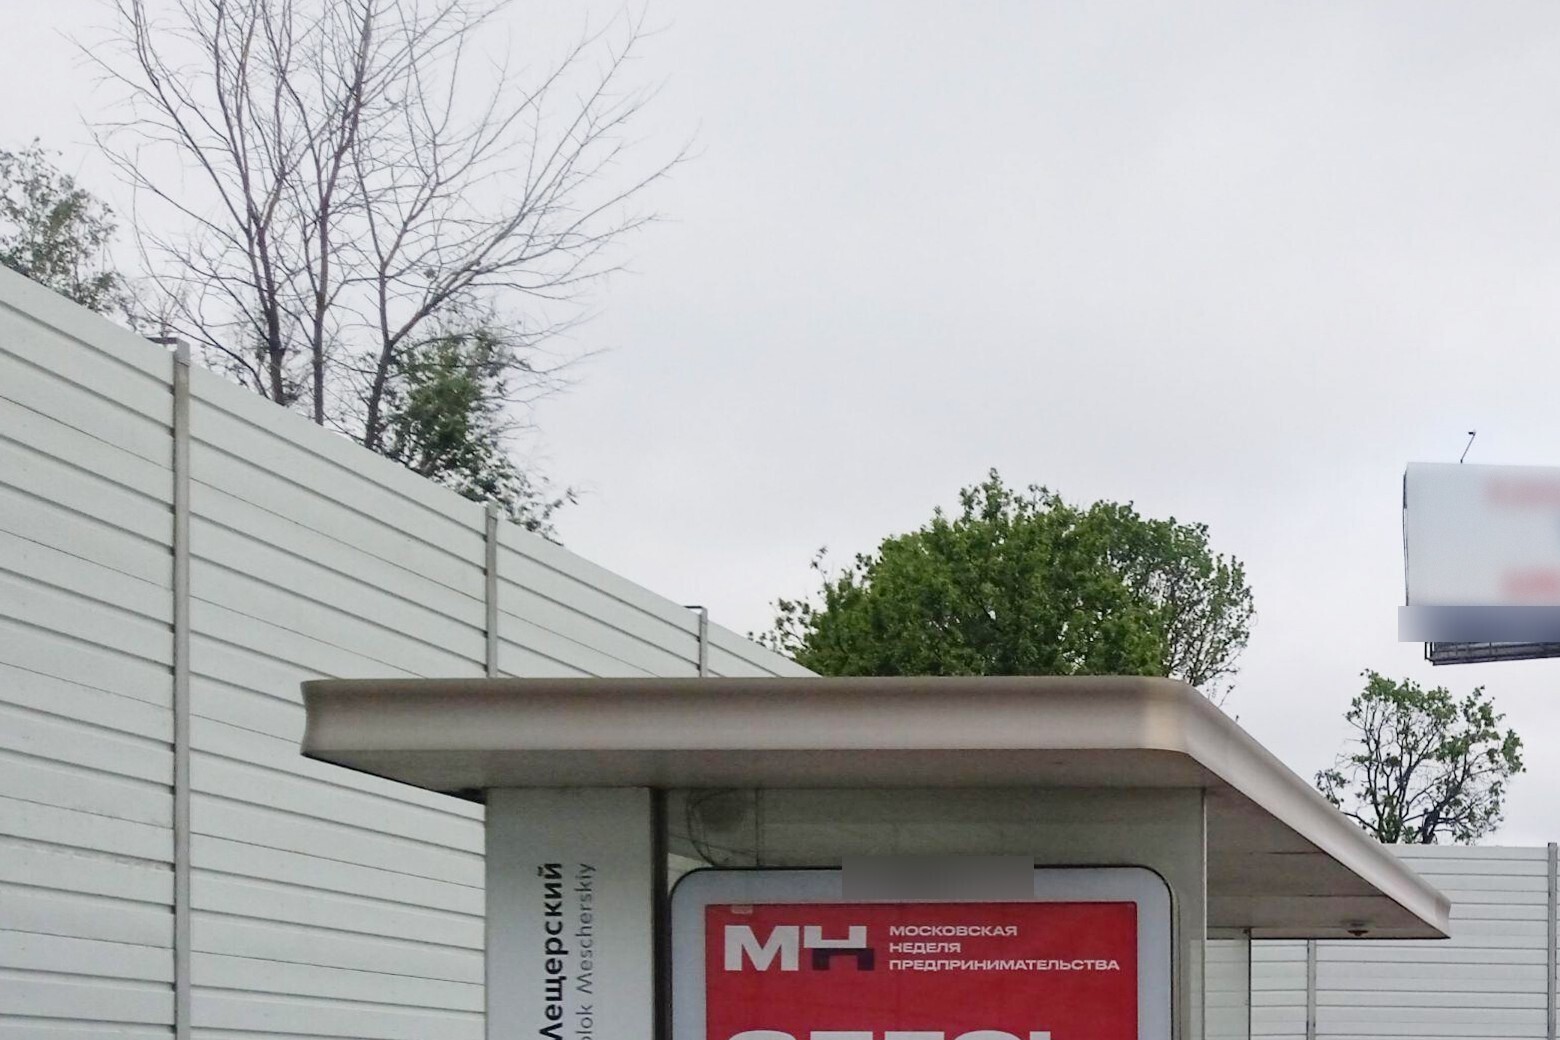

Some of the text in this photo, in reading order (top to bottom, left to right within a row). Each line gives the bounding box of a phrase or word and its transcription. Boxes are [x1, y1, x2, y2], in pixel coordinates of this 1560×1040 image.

[574, 862, 597, 995] Mescherskiy
[889, 925, 1018, 937] МОСКОВСКАЯ
[889, 942, 961, 954] НЕДЕЛЯ
[889, 959, 1120, 971] ПРЕДПРИНИМАТЕЛЬСТВА
